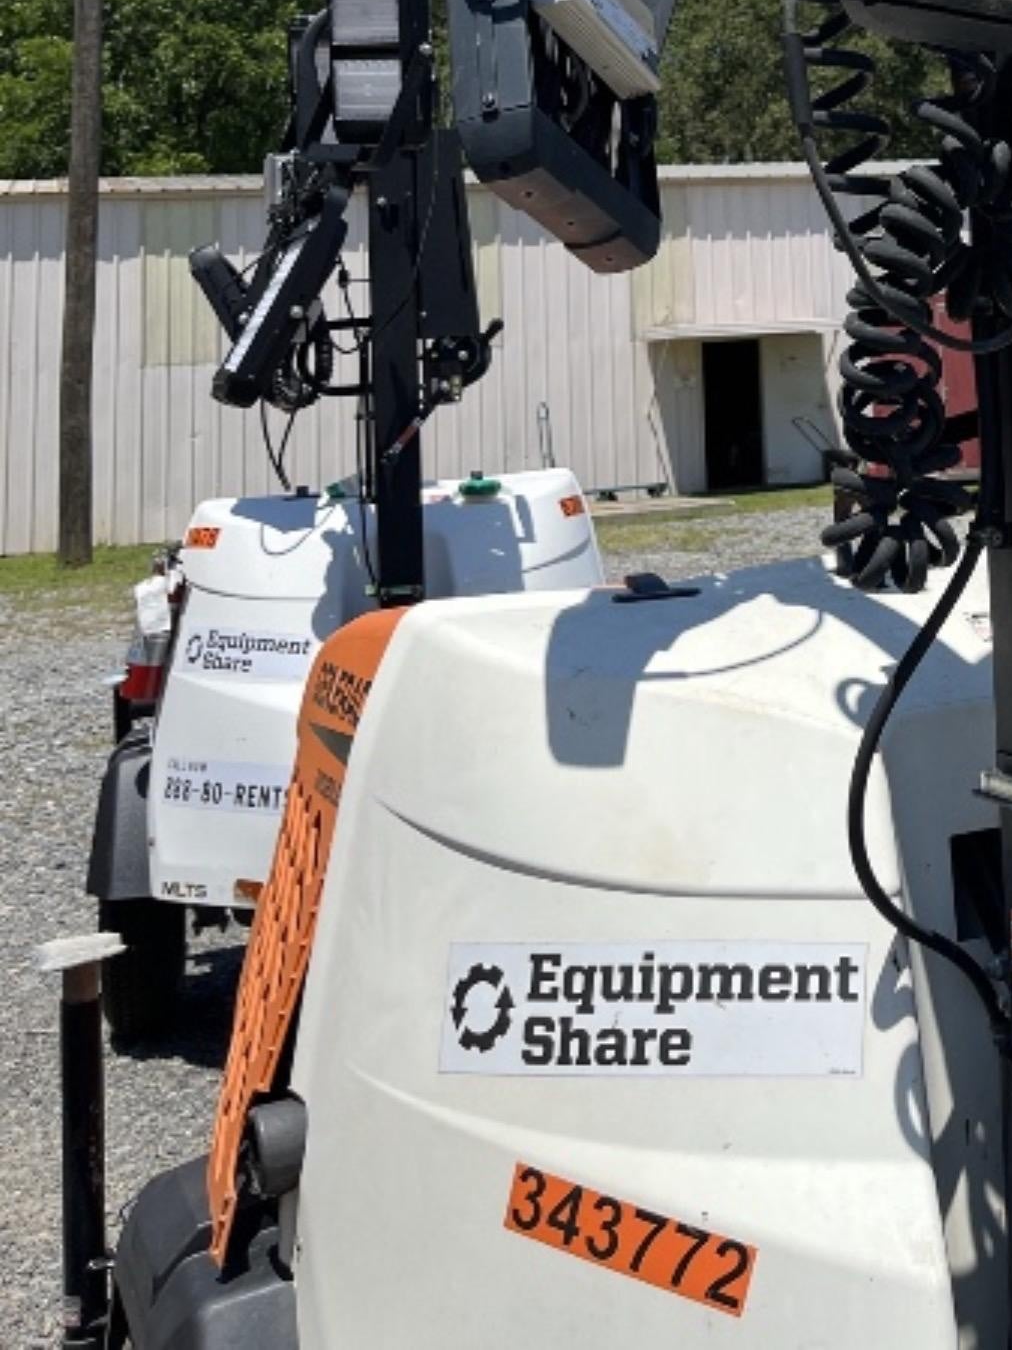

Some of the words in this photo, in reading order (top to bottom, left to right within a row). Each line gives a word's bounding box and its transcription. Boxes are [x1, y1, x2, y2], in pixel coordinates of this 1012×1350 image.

[203, 651, 252, 672] Share
[207, 629, 310, 655] Equipment
[526, 952, 859, 1016] Equipment
[521, 1016, 693, 1066] Share
[510, 1166, 751, 1309] 343772
